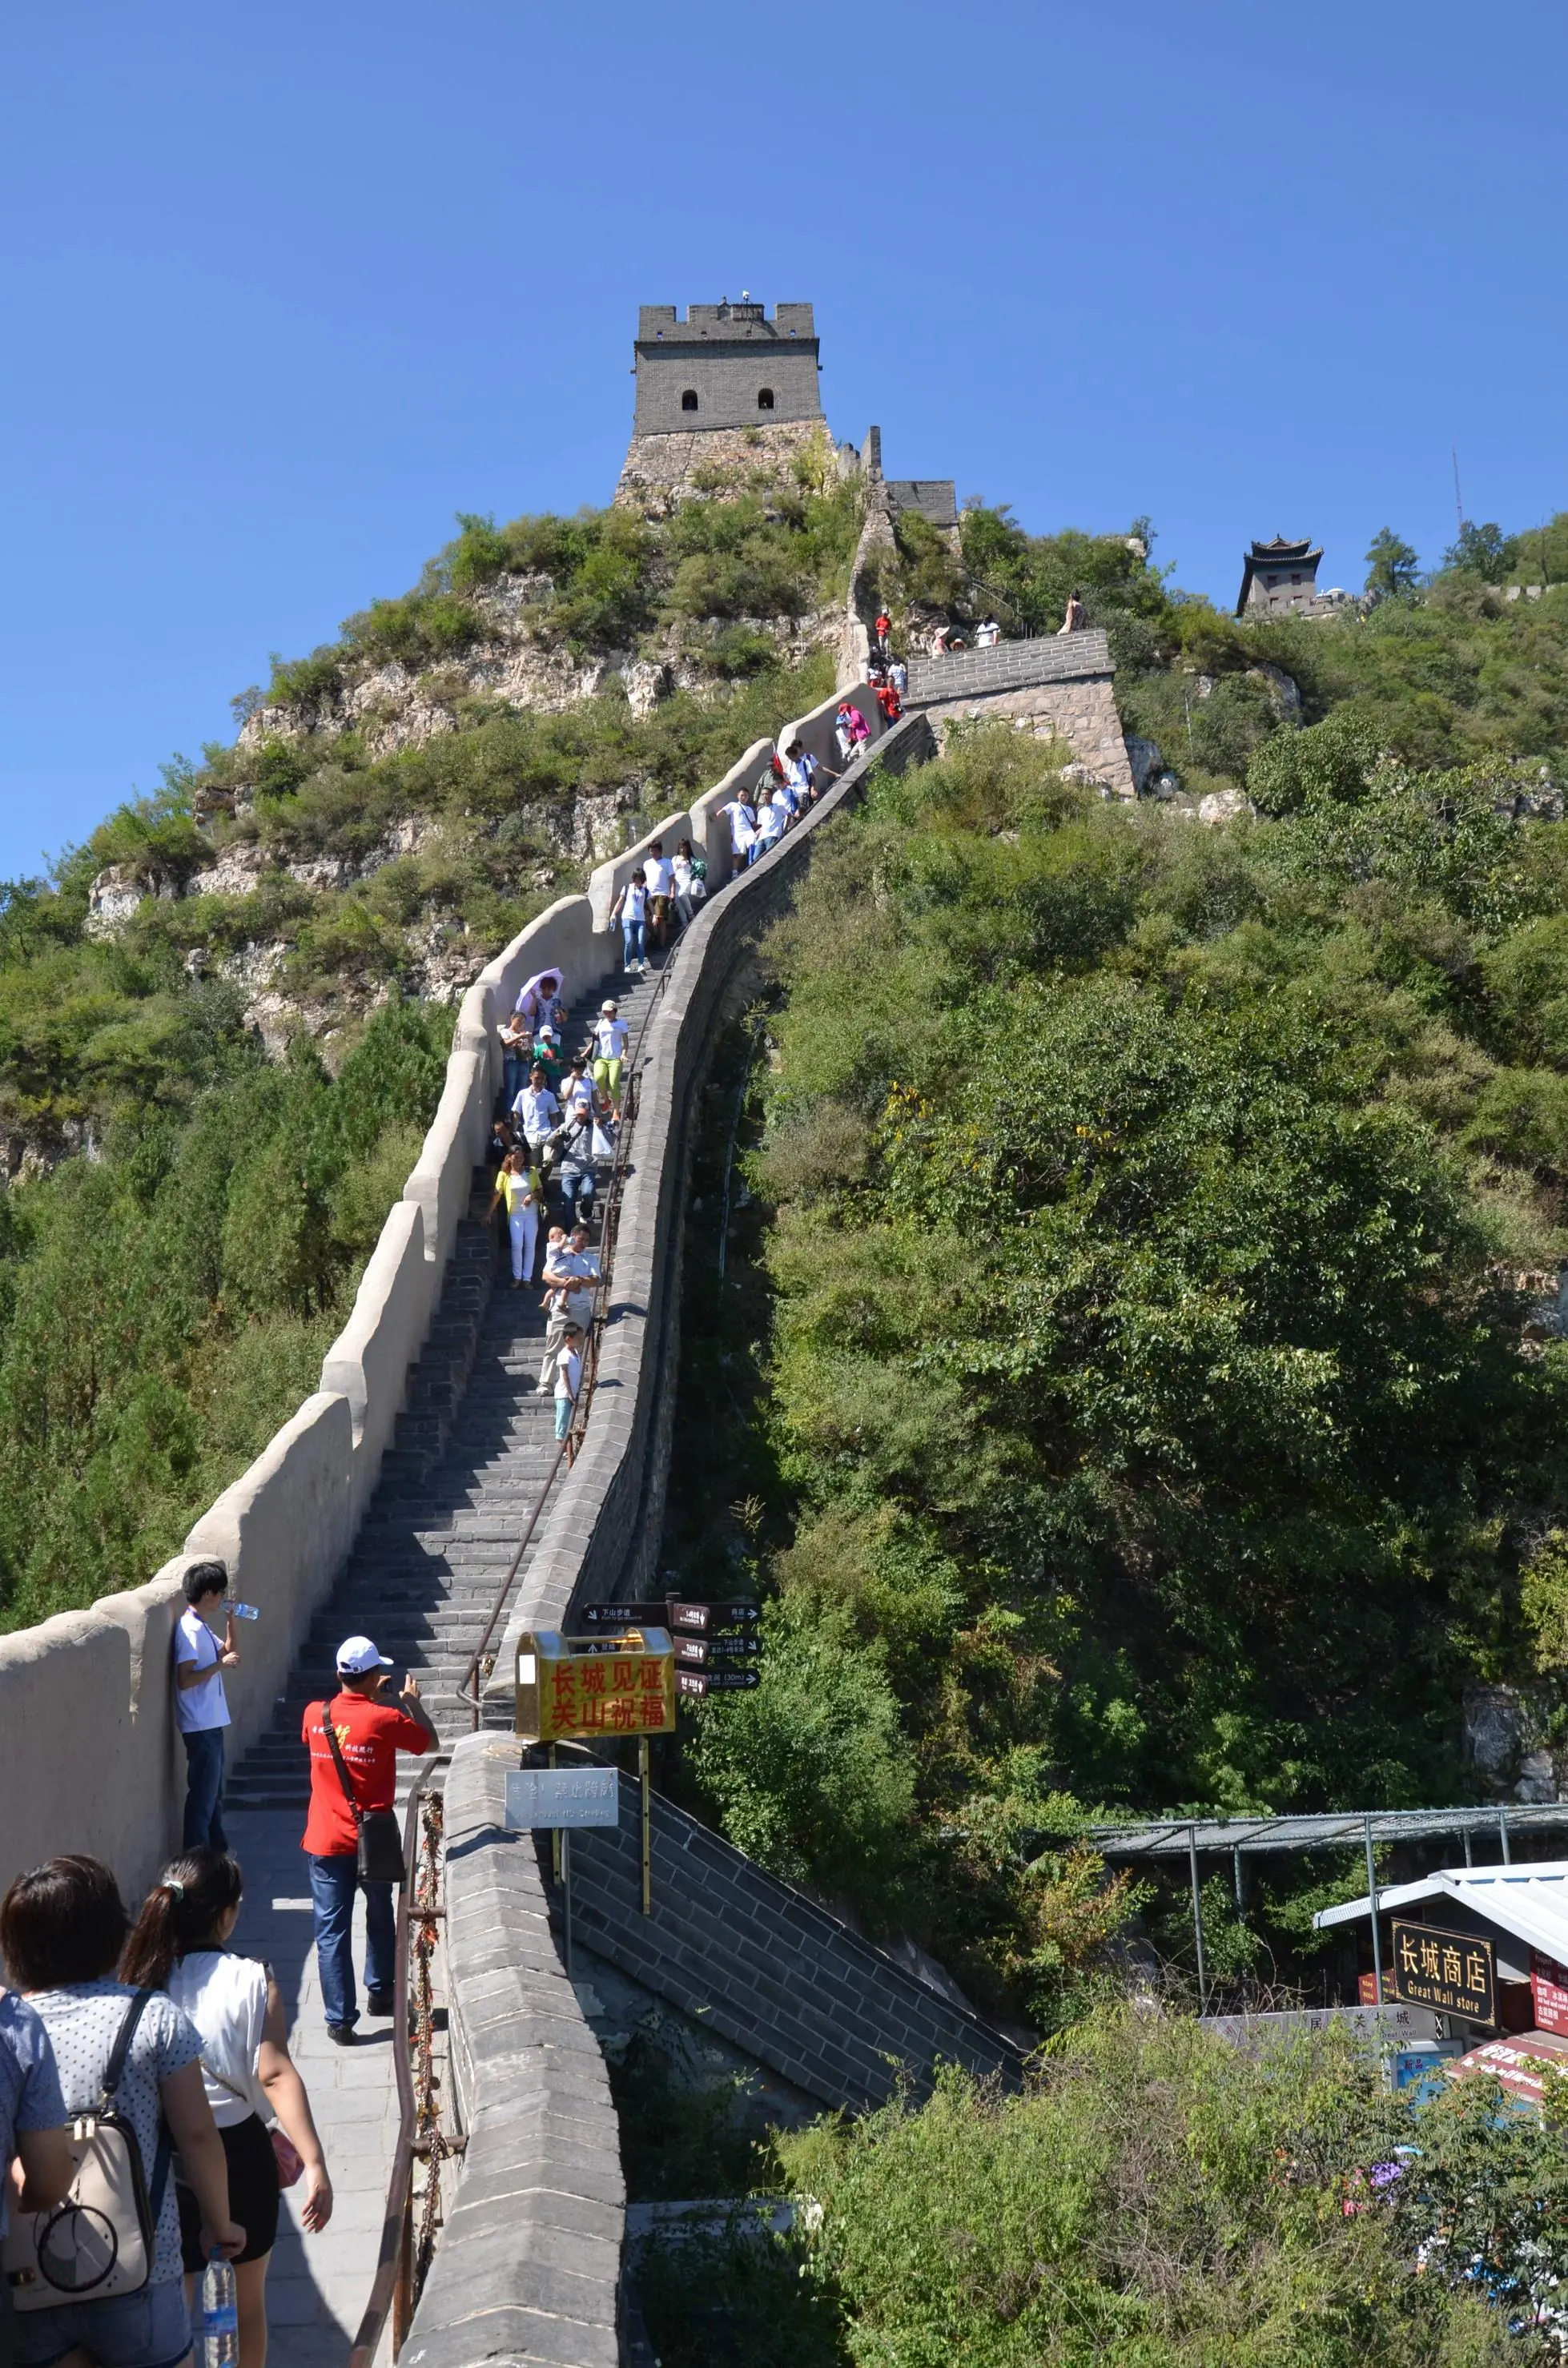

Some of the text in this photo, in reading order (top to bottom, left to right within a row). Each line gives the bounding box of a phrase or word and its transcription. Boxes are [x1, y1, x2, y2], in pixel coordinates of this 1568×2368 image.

[551, 1660, 663, 1696] 长城见证
[551, 1695, 665, 1731] 关山祝福
[1400, 1933, 1486, 1994] 长城商店
[1408, 1980, 1431, 2000] Great
[1433, 1986, 1453, 2006] Wall
[1456, 1996, 1480, 2013] store
